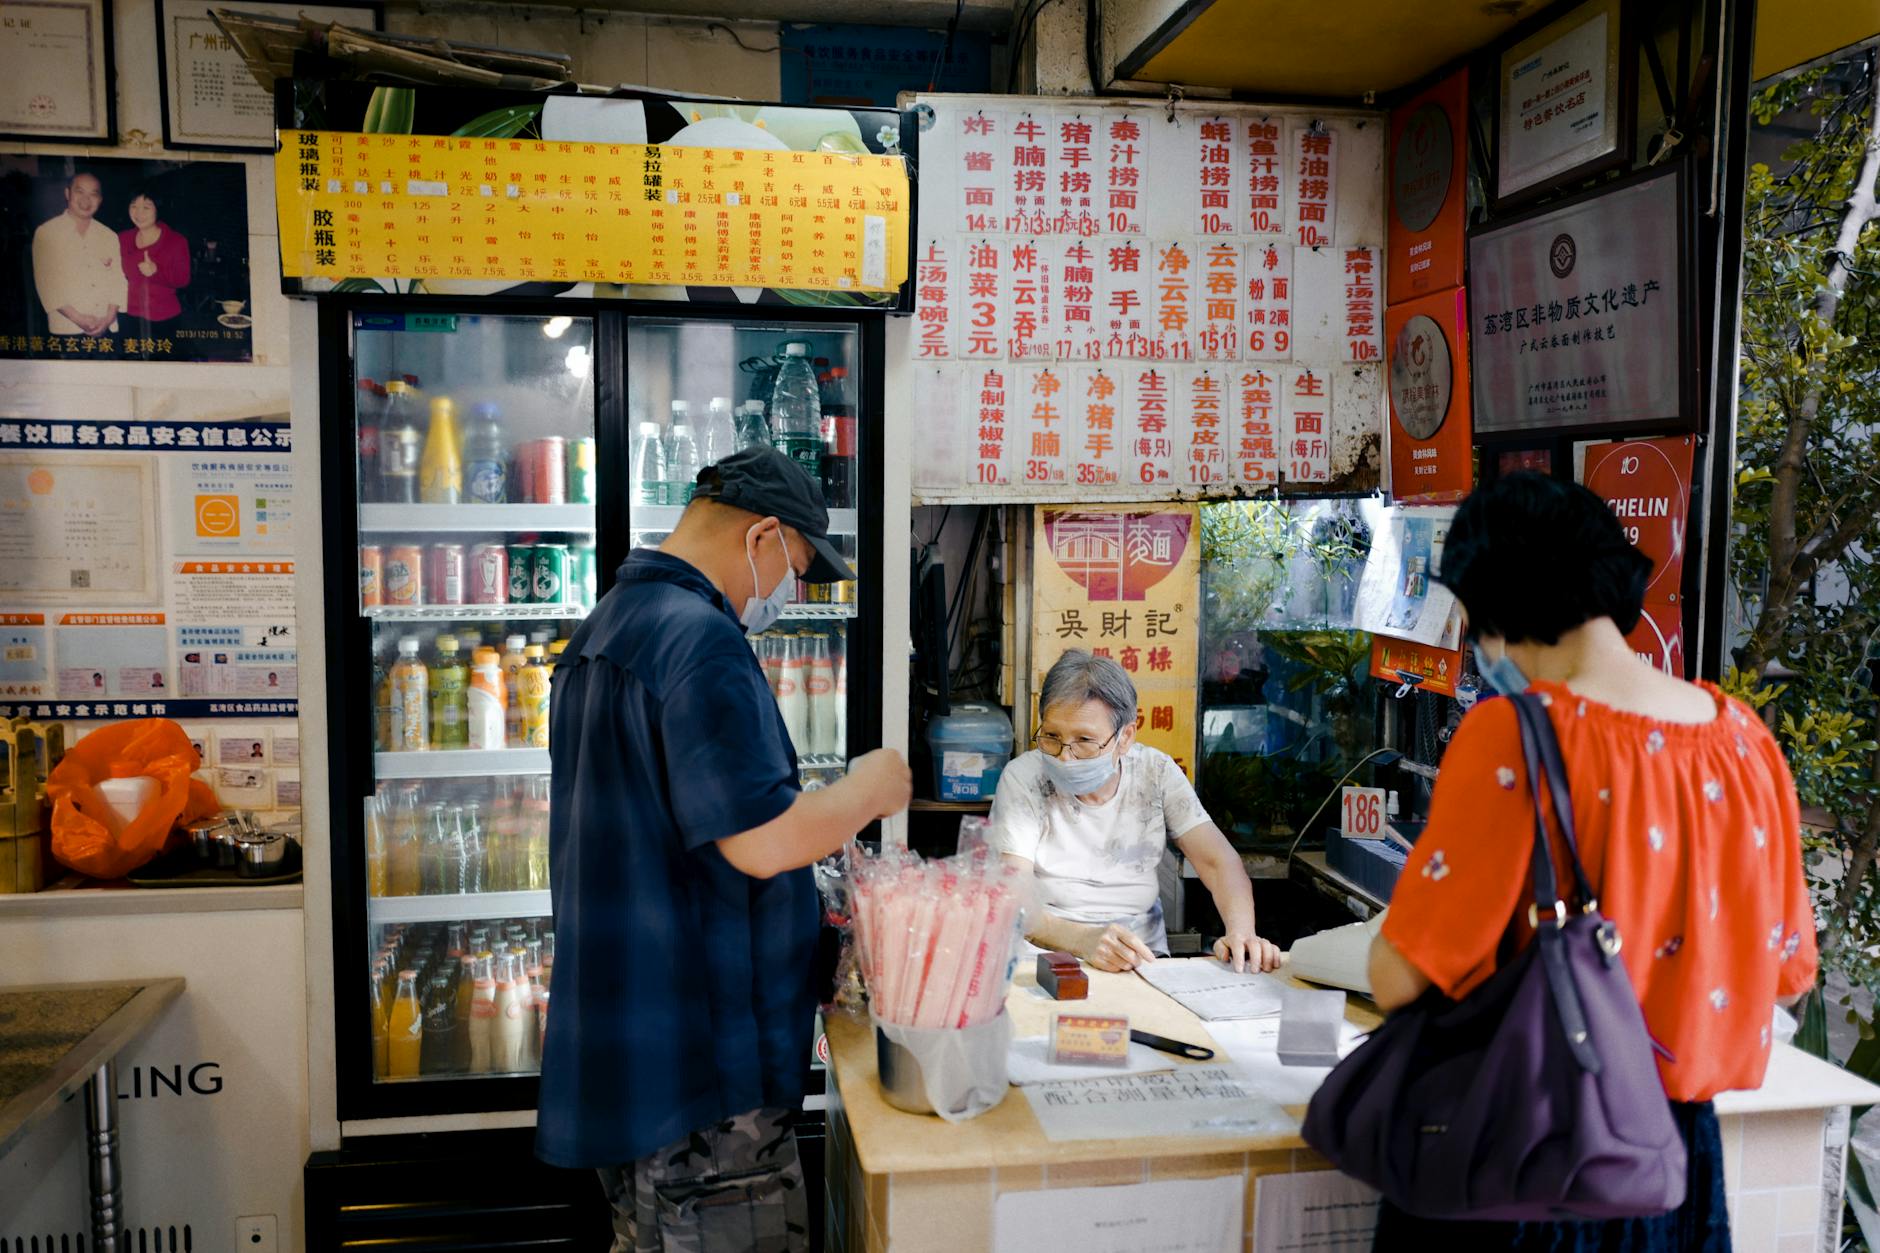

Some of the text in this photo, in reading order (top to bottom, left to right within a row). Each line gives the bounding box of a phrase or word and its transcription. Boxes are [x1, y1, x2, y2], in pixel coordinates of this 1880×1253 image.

[298, 133, 320, 191] 玻璃瓶装
[331, 136, 344, 177] 可口可乐
[357, 137, 370, 177] 美年达
[383, 138, 396, 178] 沙士
[408, 139, 422, 179] 水蜜桃
[484, 141, 497, 181] 维他奶
[534, 143, 547, 183] 珠啤
[559, 144, 571, 184] 纯生
[583, 145, 598, 185] 哈啤
[608, 146, 621, 185] 百威
[643, 146, 662, 201] 易拉罐装
[672, 148, 684, 189] 可乐
[703, 150, 714, 190] 美年达
[732, 151, 744, 191] 雪碧
[763, 153, 775, 192] 王老吉
[793, 153, 804, 193] 红牛
[823, 155, 833, 195] 百威
[963, 115, 996, 206] 炸酱面
[1013, 120, 1046, 192] 牛腩捞
[1060, 122, 1093, 193] 猪手捞
[1200, 121, 1231, 209] 蚝油捞面
[1248, 122, 1279, 210] 鲍鱼汁捞面
[1298, 134, 1332, 223] 猪油捞面
[314, 210, 336, 266] 胶瓶装
[518, 205, 532, 266] 大怡宝
[552, 206, 566, 267] 中怡宝
[585, 207, 599, 267] 小怡宝
[618, 209, 632, 268] 脉动
[965, 213, 997, 231] 14元
[1108, 212, 1141, 233] 10元
[1200, 213, 1233, 234] 10元
[1250, 211, 1282, 233] 10元
[1298, 226, 1329, 246] 10元
[781, 214, 793, 273] 阿萨姆奶茶
[812, 215, 826, 274] 营养快线
[1263, 248, 1279, 271] 净
[918, 245, 949, 357] 上汤每碗2元
[968, 244, 999, 354] 油菜3元
[1012, 244, 1037, 339] 炸云吞
[1064, 245, 1094, 322] 牛腩粉面
[1108, 246, 1141, 316] 猪手
[1158, 246, 1190, 331] 净云吞
[1206, 246, 1238, 321] 云吞面
[1249, 278, 1288, 301] 粉 面
[1345, 250, 1374, 336] 爽滑上汤云吞皮
[1249, 309, 1289, 326] 1两 2两
[1485, 280, 1660, 335] 荔湾区非物质文化遗产
[123, 338, 173, 354] 麦玲玲
[1250, 330, 1289, 352] 6 9
[1350, 341, 1378, 360] 10元
[1519, 324, 1616, 354] 广式云吞面制作技艺
[979, 372, 1004, 459] 自制辣椒酱
[1032, 371, 1061, 457] 净牛腩
[1085, 373, 1115, 459] 净猪手
[1138, 372, 1168, 433] 生云吞
[1191, 377, 1220, 445] 生云吞皮
[1240, 373, 1272, 449] 外卖打包碗
[1294, 373, 1324, 434] 生面
[0, 424, 291, 447] 餐饮服务食品安全信息公示
[1134, 438, 1171, 458] (每只)
[1188, 449, 1224, 463] (每斤)
[1291, 439, 1328, 458] (每斤)
[1189, 465, 1223, 482] 10元
[1290, 461, 1326, 480] 10元
[1606, 497, 1668, 517] CHELIN
[1127, 520, 1173, 567] 麵
[210, 703, 298, 713] 荔湾区食品药品监督管
[1344, 793, 1379, 834] 186
